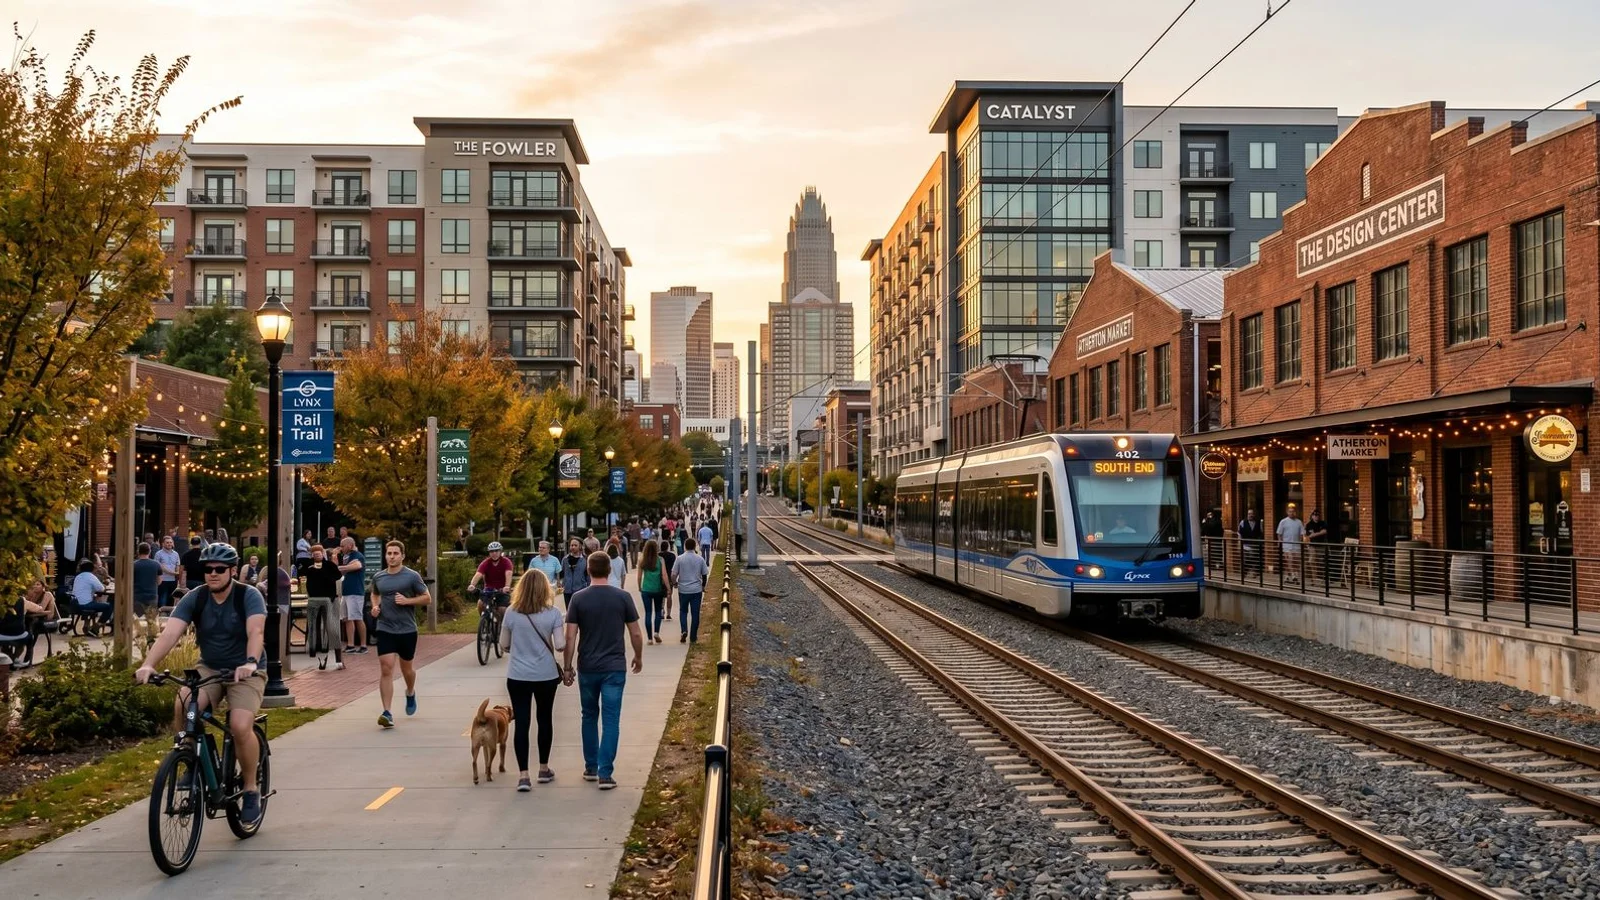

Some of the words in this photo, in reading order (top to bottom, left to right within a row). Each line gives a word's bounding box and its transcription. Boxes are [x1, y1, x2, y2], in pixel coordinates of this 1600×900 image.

[986, 104, 1076, 120] CATALYST
[454, 141, 478, 151] THE
[482, 141, 556, 156] FOWLER
[1300, 238, 1324, 267] THE
[1326, 216, 1374, 258] DESIGN
[1378, 189, 1438, 236] CENTER
[1107, 319, 1132, 343] MARKET
[294, 398, 321, 407] LYNX
[294, 413, 321, 426] Rail
[290, 427, 323, 440] Trail
[1332, 438, 1387, 447] ATHERTON
[1115, 450, 1140, 459] 402
[1341, 448, 1378, 456] MARKET
[440, 456, 468, 464] South
[445, 464, 463, 473] End
[1095, 462, 1131, 473] SOUTH
[1134, 462, 1155, 473] END
